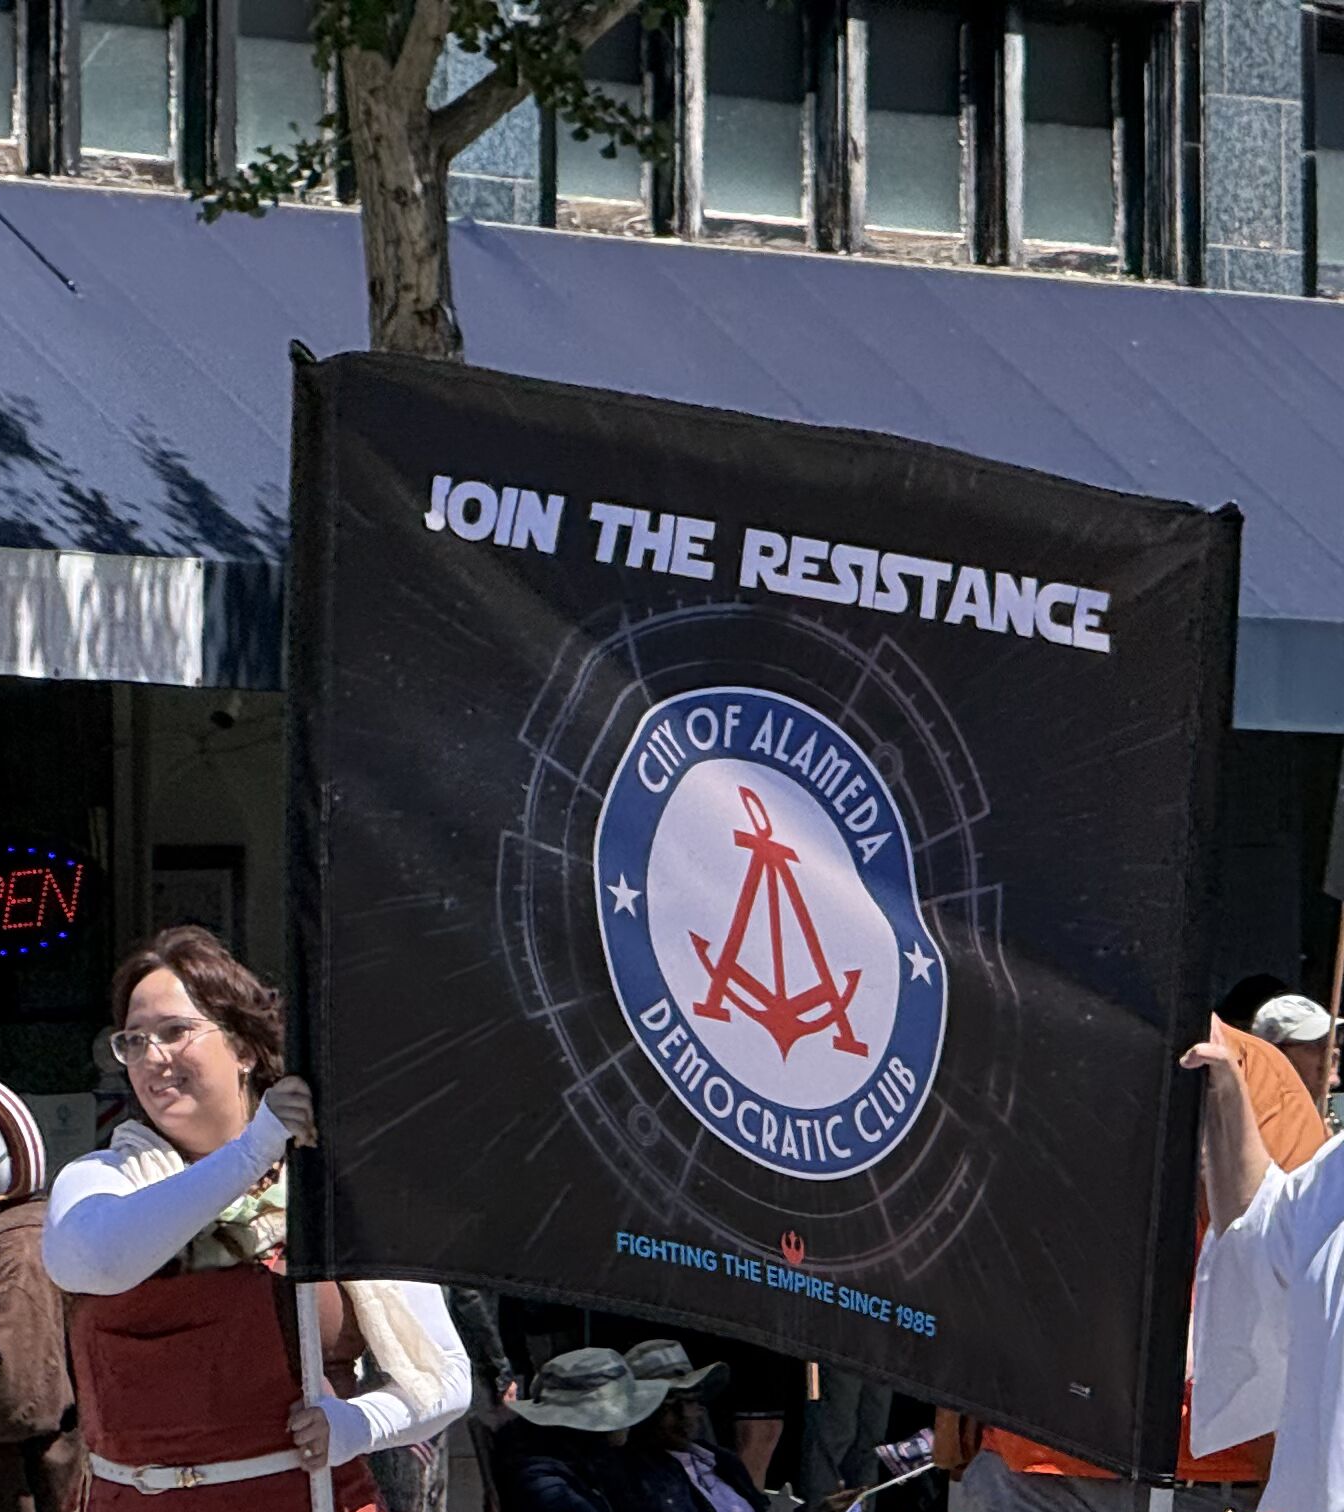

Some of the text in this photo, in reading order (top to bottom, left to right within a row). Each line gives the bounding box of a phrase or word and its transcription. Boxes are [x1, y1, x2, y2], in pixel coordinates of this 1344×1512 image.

[424, 475, 1111, 653] JOIN THE RESISTANCE
[637, 704, 894, 865] CITY OF ALAMEDA
[639, 998, 916, 1162] DEMOCRATIC CLUB
[616, 1231, 937, 1338] FIGHTING THE EMPIRE SINCE 1985
